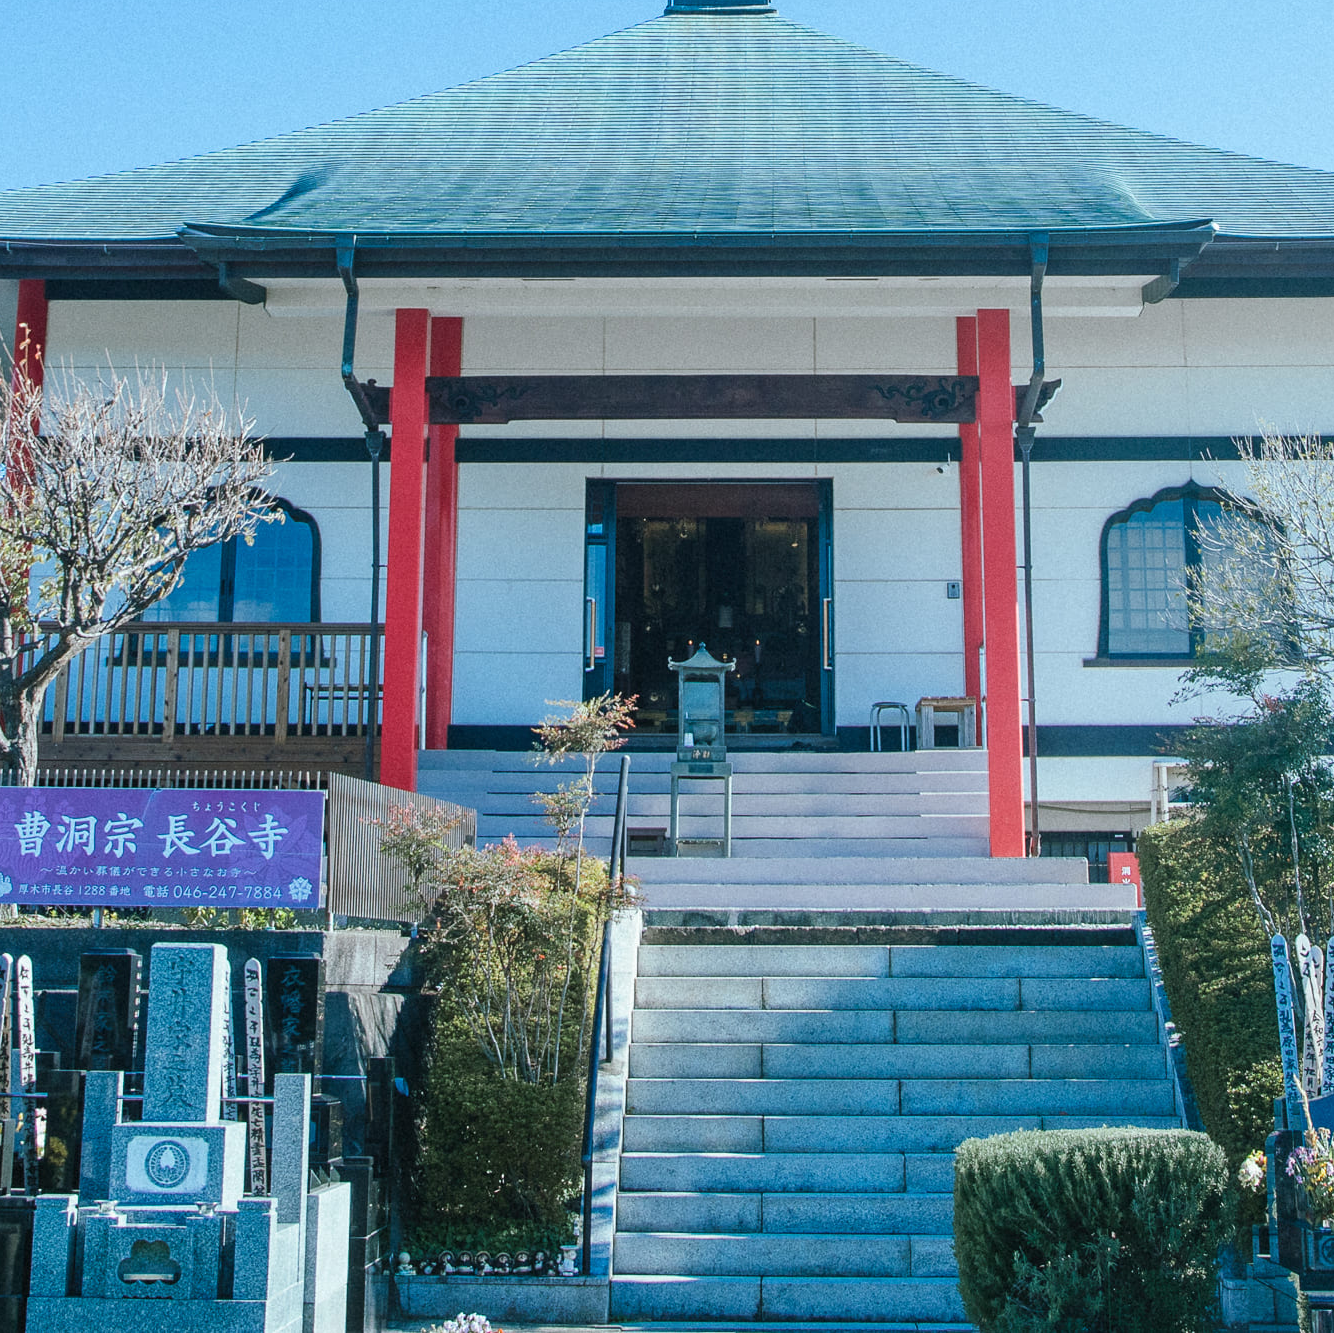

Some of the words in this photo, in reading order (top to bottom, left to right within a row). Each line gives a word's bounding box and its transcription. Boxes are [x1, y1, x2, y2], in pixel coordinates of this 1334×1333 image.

[192, 801, 262, 813] ちょうこくじ
[13, 810, 145, 859] 曹洞宗
[156, 813, 289, 860] 長谷寺
[173, 885, 283, 900] 046-247-7884
